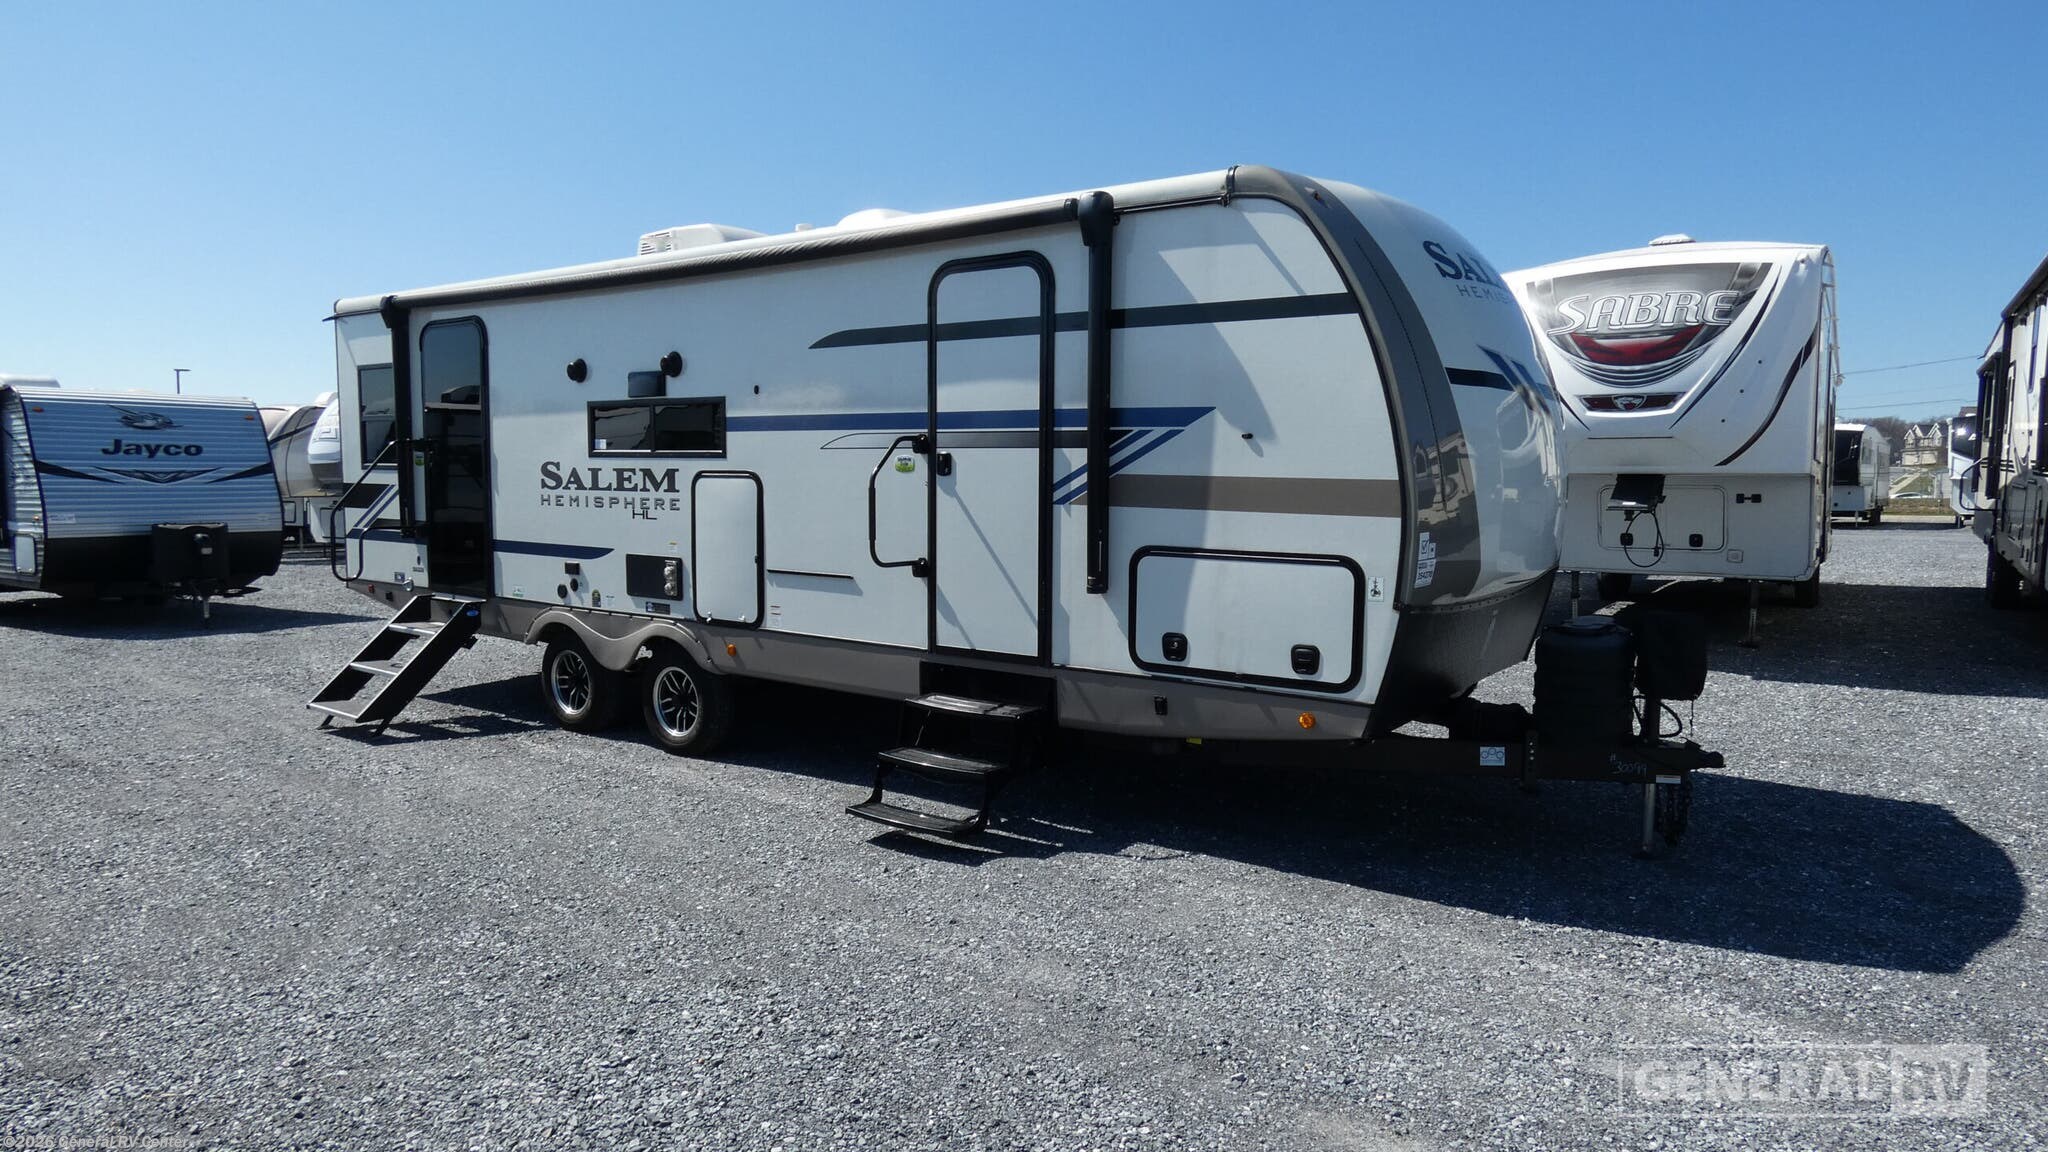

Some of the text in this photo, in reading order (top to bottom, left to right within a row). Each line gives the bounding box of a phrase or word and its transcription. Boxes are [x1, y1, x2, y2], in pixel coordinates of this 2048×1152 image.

[1423, 240, 1504, 289] SAL
[1547, 290, 1740, 336] SABRE
[101, 438, 203, 459] Jayco
[540, 461, 680, 493] SALEM
[540, 494, 681, 511] HEMISPHERE
[632, 509, 657, 520] HL
